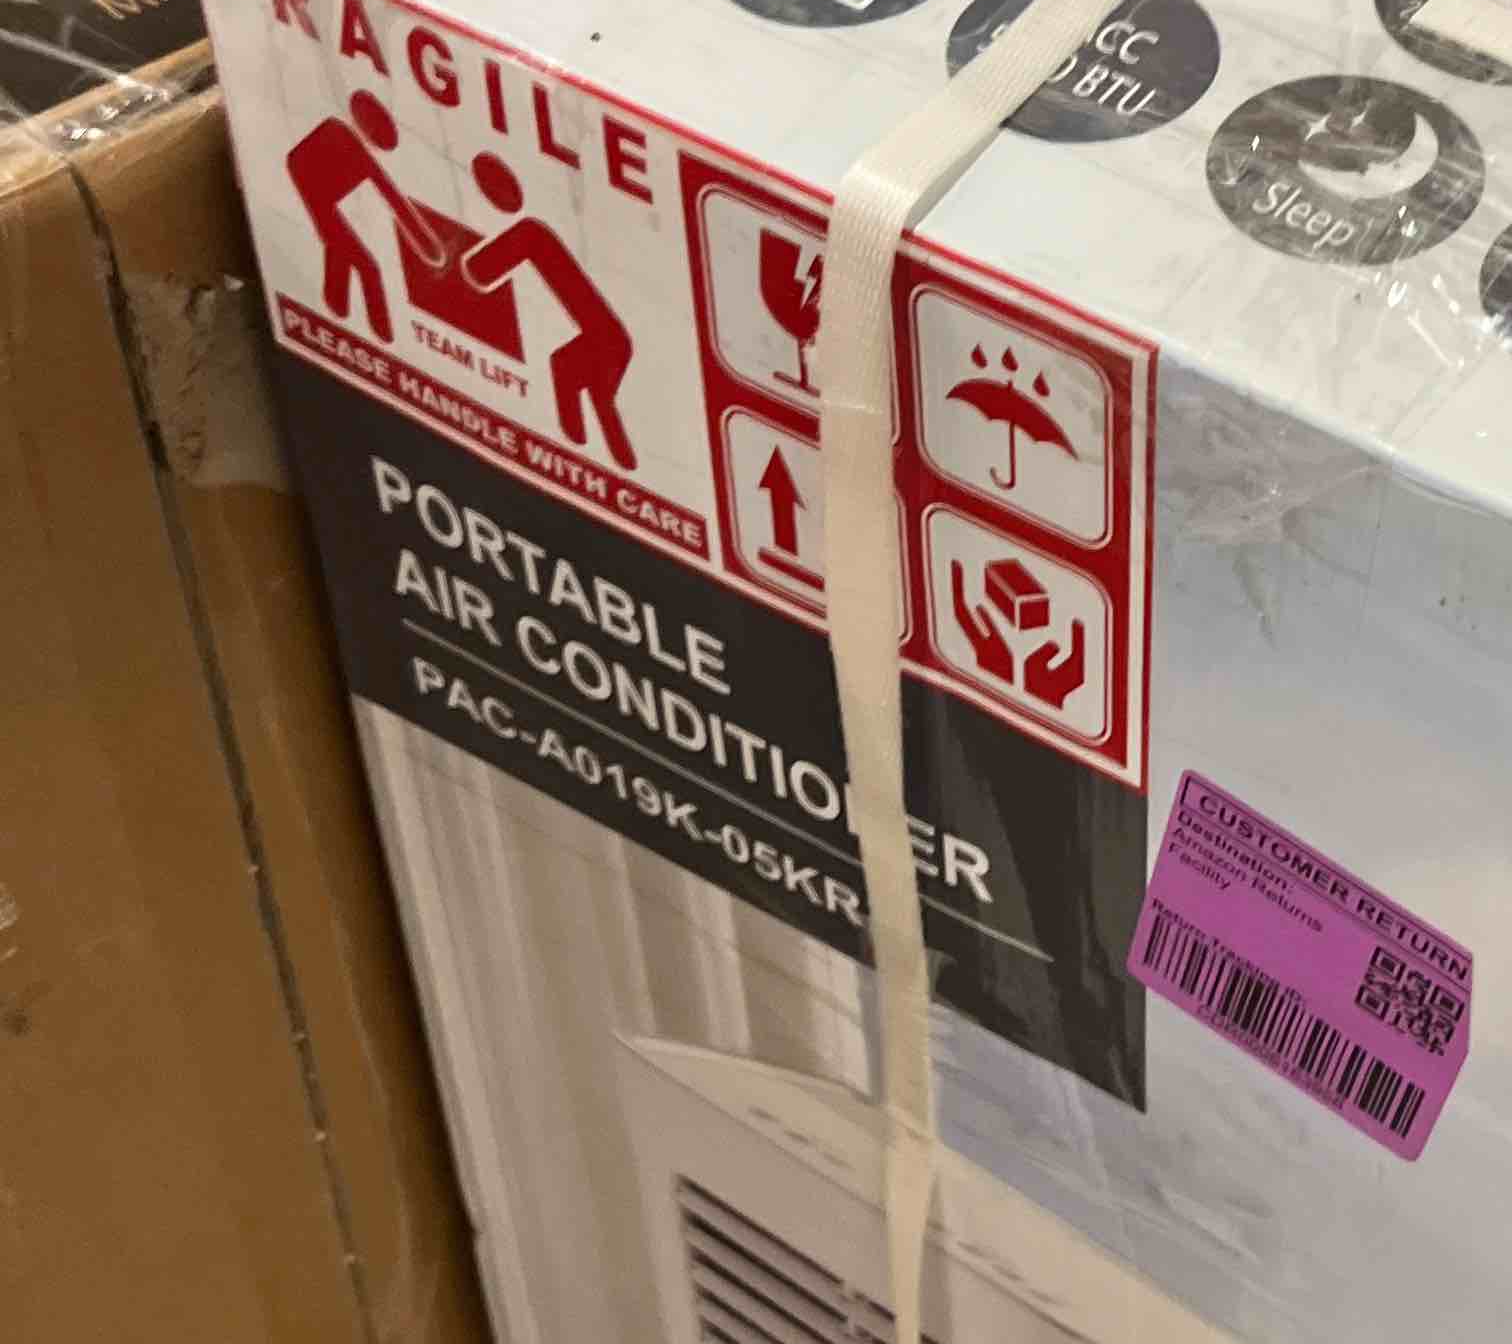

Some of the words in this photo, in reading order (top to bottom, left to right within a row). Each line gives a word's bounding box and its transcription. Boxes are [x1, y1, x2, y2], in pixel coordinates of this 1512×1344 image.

[1071, 64, 1158, 117] BTU
[1252, 181, 1356, 250] Sleep
[282, 307, 391, 387] PLEASE
[397, 368, 517, 458] HANDLE
[524, 436, 607, 503] WITH
[615, 483, 704, 554] CARE
[410, 319, 477, 374] TEAM
[478, 352, 533, 405] LIFT
[368, 454, 732, 700] PORTABLE
[385, 539, 501, 649] AIR
[512, 608, 992, 909] CONDITIOER
[1170, 824, 1248, 883] Amazon
[1249, 875, 1325, 934] Returns
[1196, 792, 1351, 904] CUSTOMER
[1354, 894, 1469, 981] RETURN
